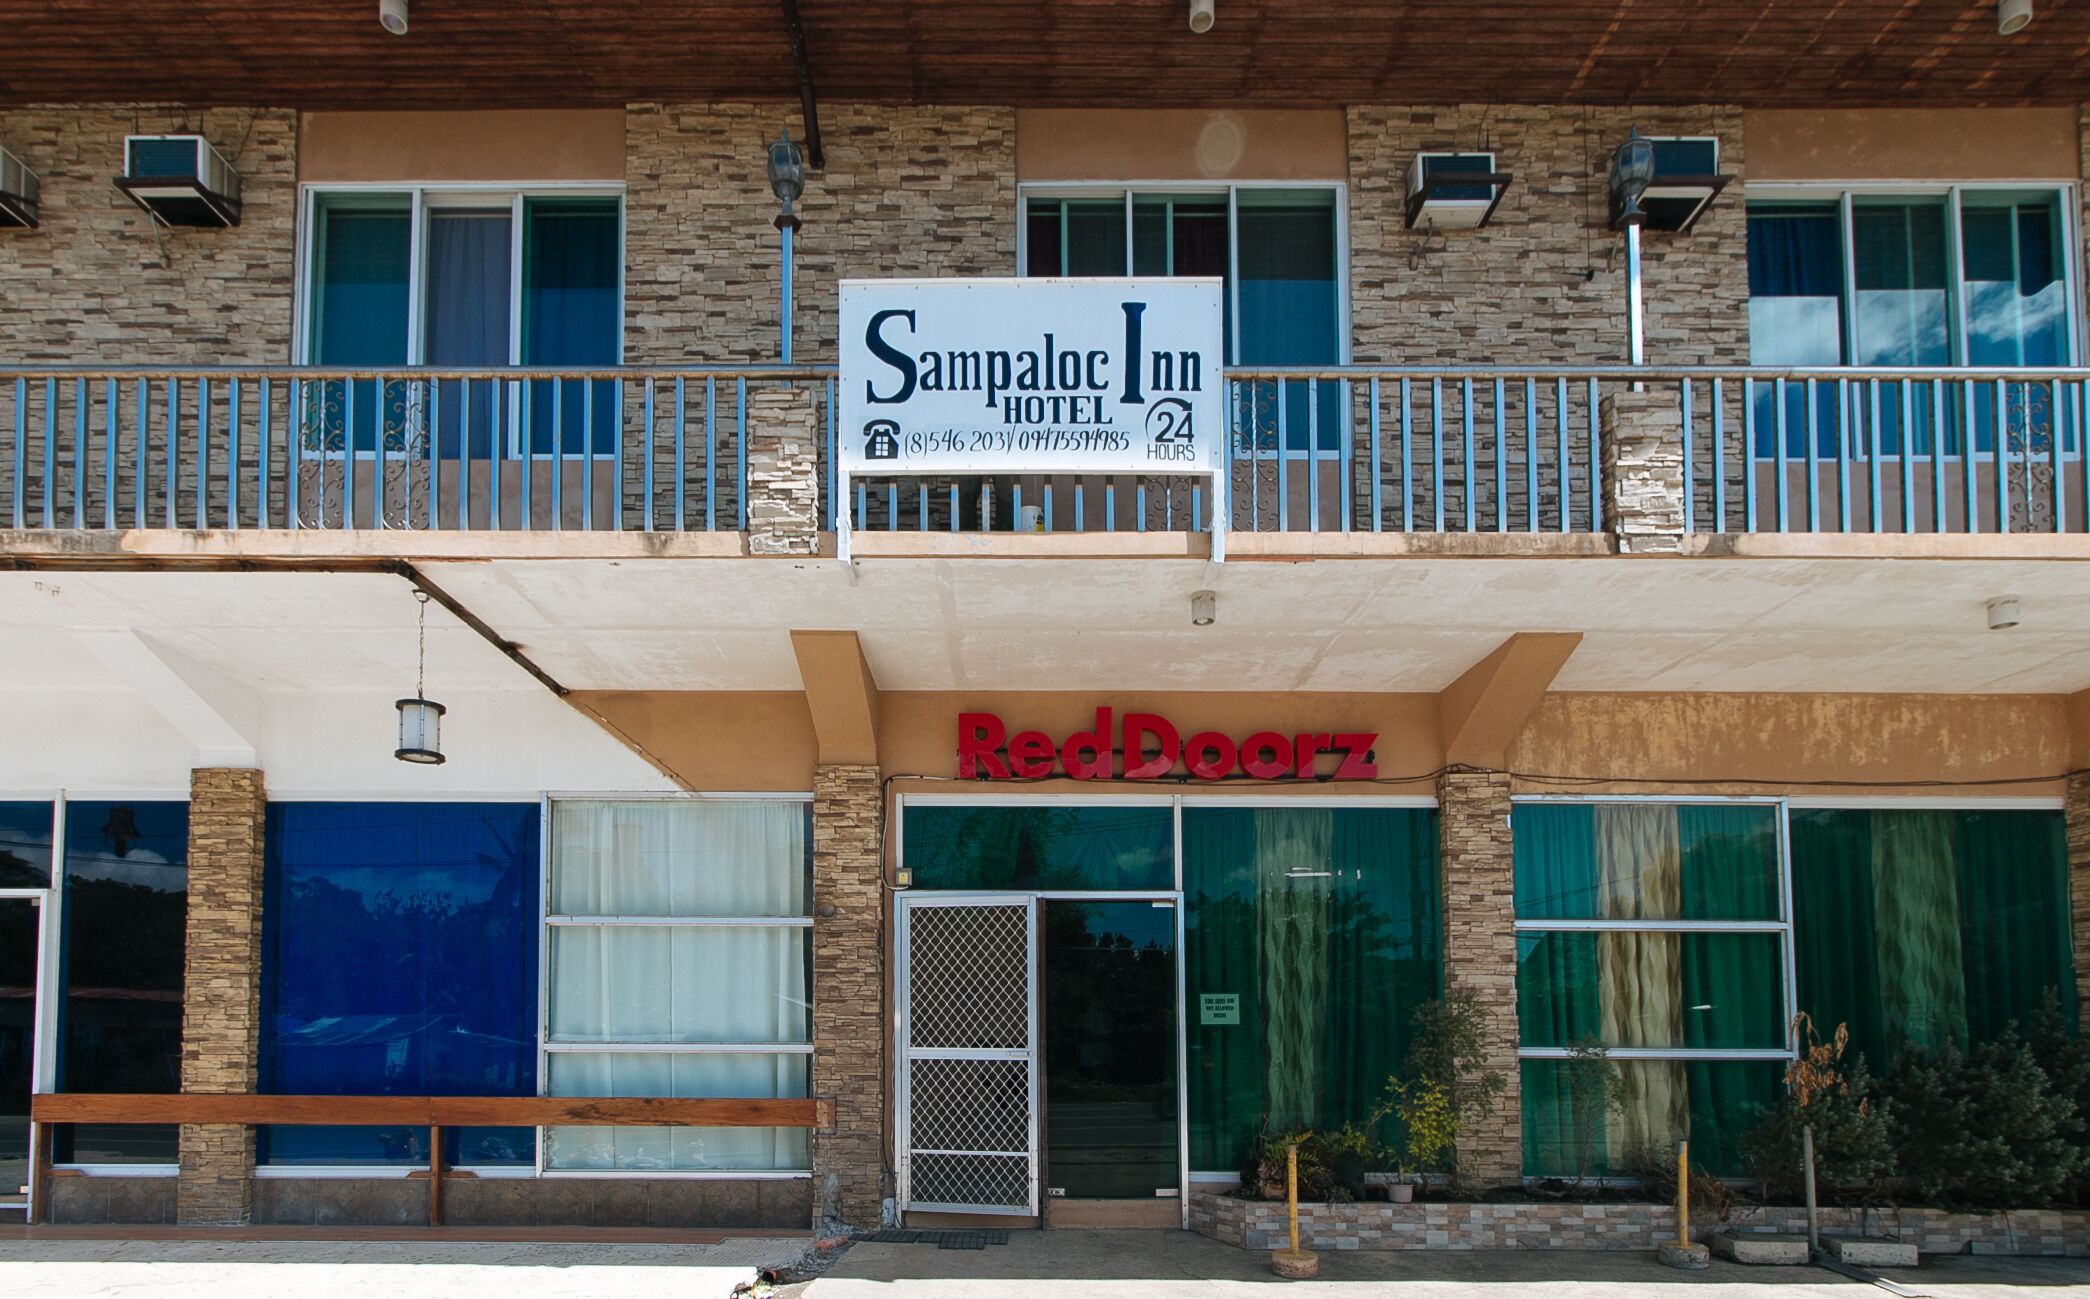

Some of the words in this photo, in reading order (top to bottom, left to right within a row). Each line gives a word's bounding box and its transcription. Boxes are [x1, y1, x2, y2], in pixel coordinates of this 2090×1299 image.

[865, 309, 1110, 408] Sampaloc
[1120, 301, 1202, 405] Inn
[1003, 395, 1113, 425] HOTEL
[1155, 411, 1195, 444] 24
[1146, 444, 1195, 461] HOURS
[957, 705, 1379, 781] RedDoorz
